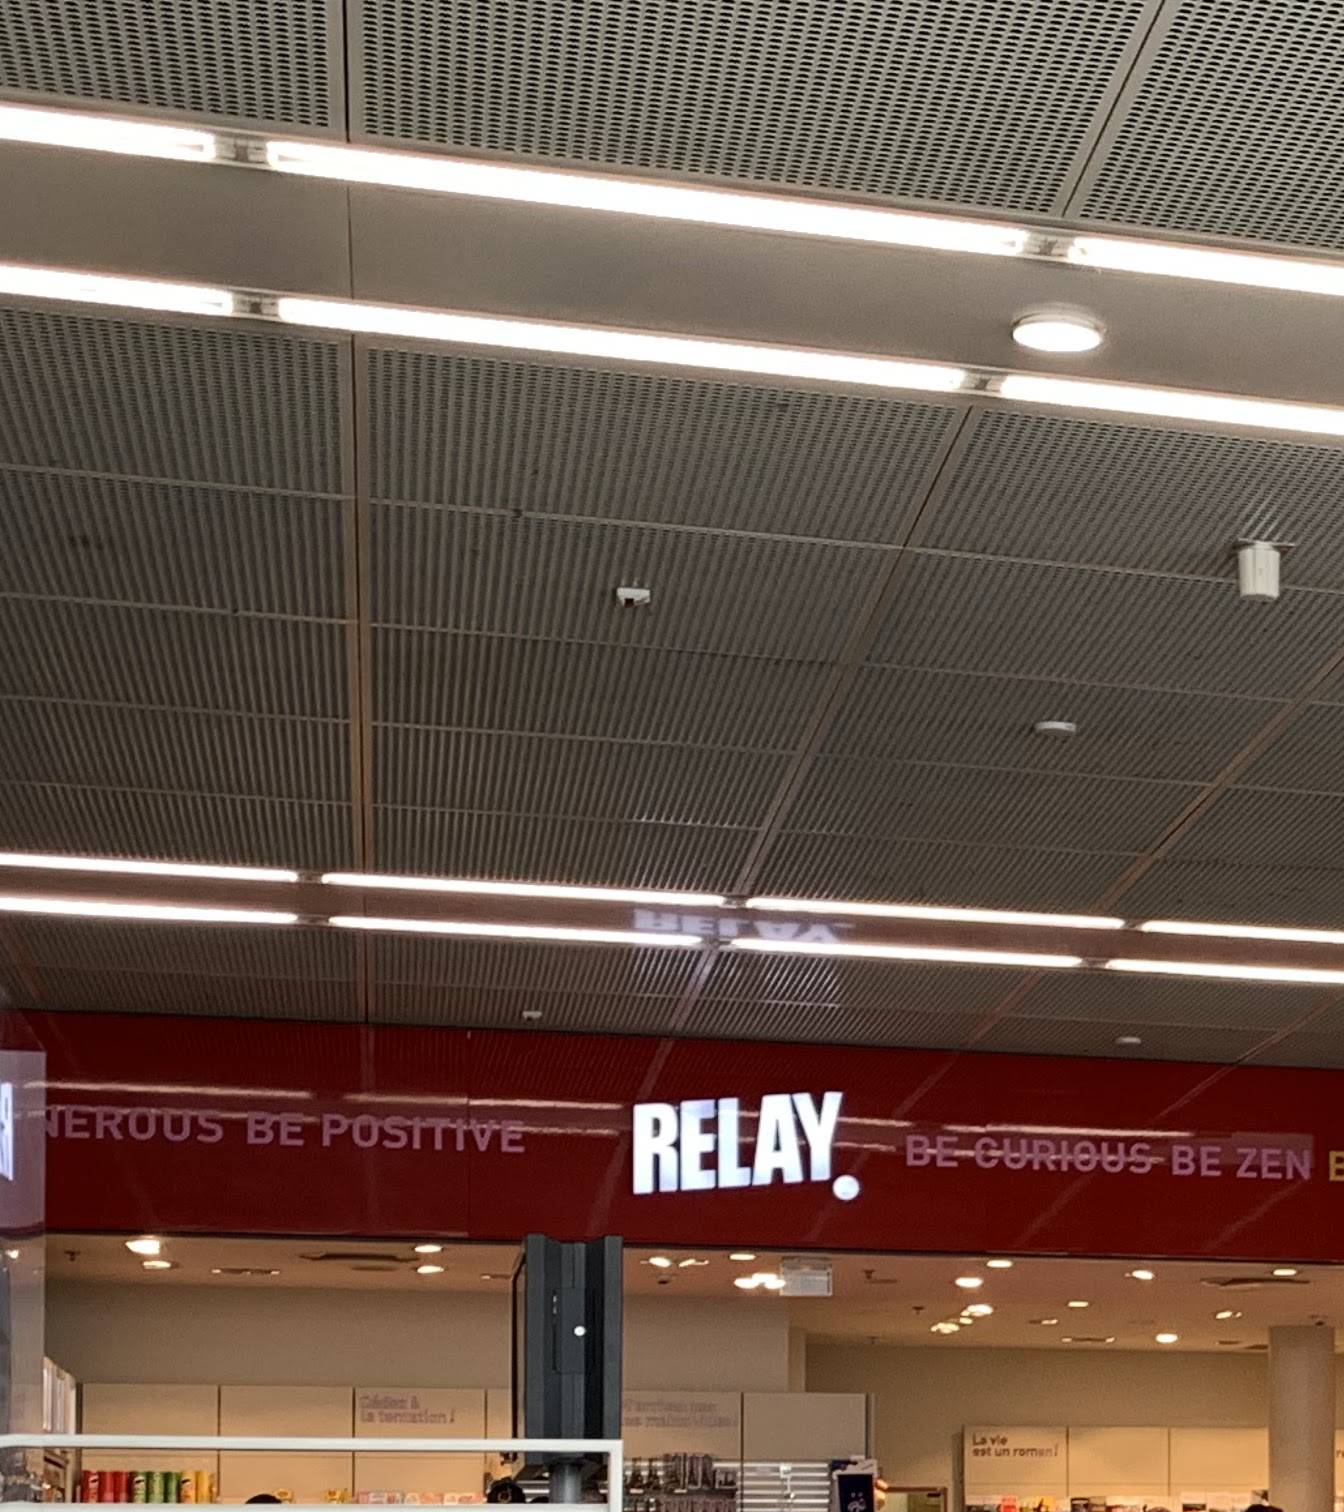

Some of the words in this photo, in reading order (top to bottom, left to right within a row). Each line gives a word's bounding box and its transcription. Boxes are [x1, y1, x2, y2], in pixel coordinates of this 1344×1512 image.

[247, 1111, 304, 1146] BE
[322, 1114, 525, 1152] POSITIVE
[906, 1135, 958, 1167] BE
[974, 1137, 1151, 1174] CURIOUS
[1172, 1145, 1221, 1176] BE
[1236, 1148, 1311, 1180] ZEN
